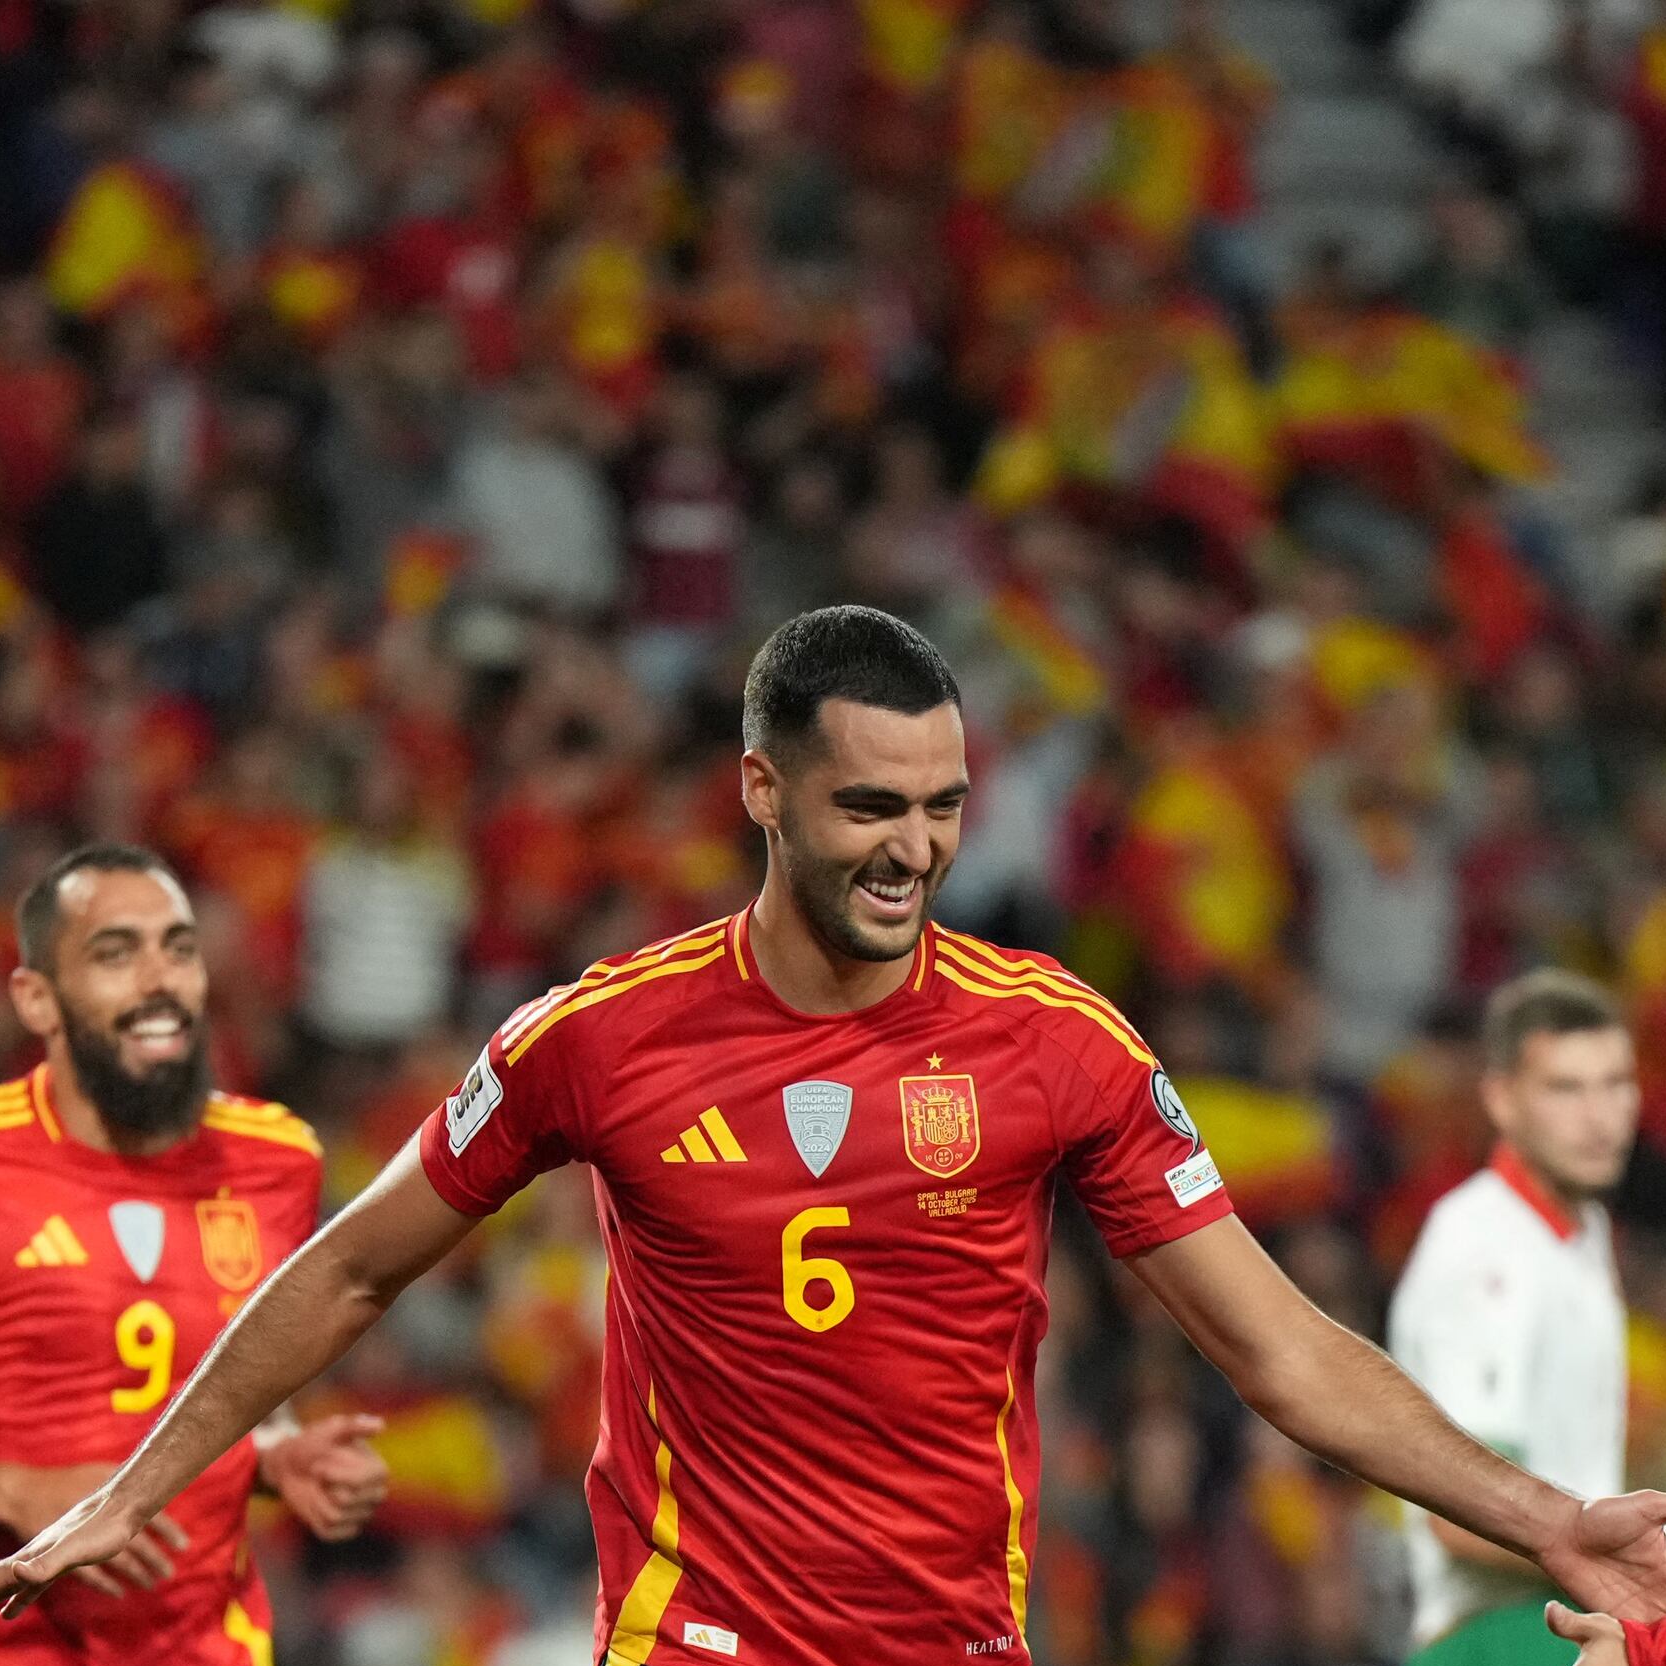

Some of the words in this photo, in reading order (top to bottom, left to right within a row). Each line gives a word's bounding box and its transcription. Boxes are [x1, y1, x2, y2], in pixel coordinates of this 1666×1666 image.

[805, 1086, 829, 1094] UEFA
[790, 1095, 844, 1104] EUROPEAN
[790, 1104, 845, 1113] CHAMPIONS
[804, 1143, 831, 1153] 2024
[917, 1191, 939, 1202] SPAIN
[944, 1187, 978, 1200] BULGARIA
[917, 1201, 927, 1210] 14
[928, 1198, 959, 1209] OCTOBER
[959, 1195, 977, 1205] 2025
[928, 1204, 967, 1218] VALLADOLID
[781, 1206, 856, 1333] 6
[110, 1298, 176, 1414] 9
[966, 1634, 1014, 1657] HEAT.RDY
